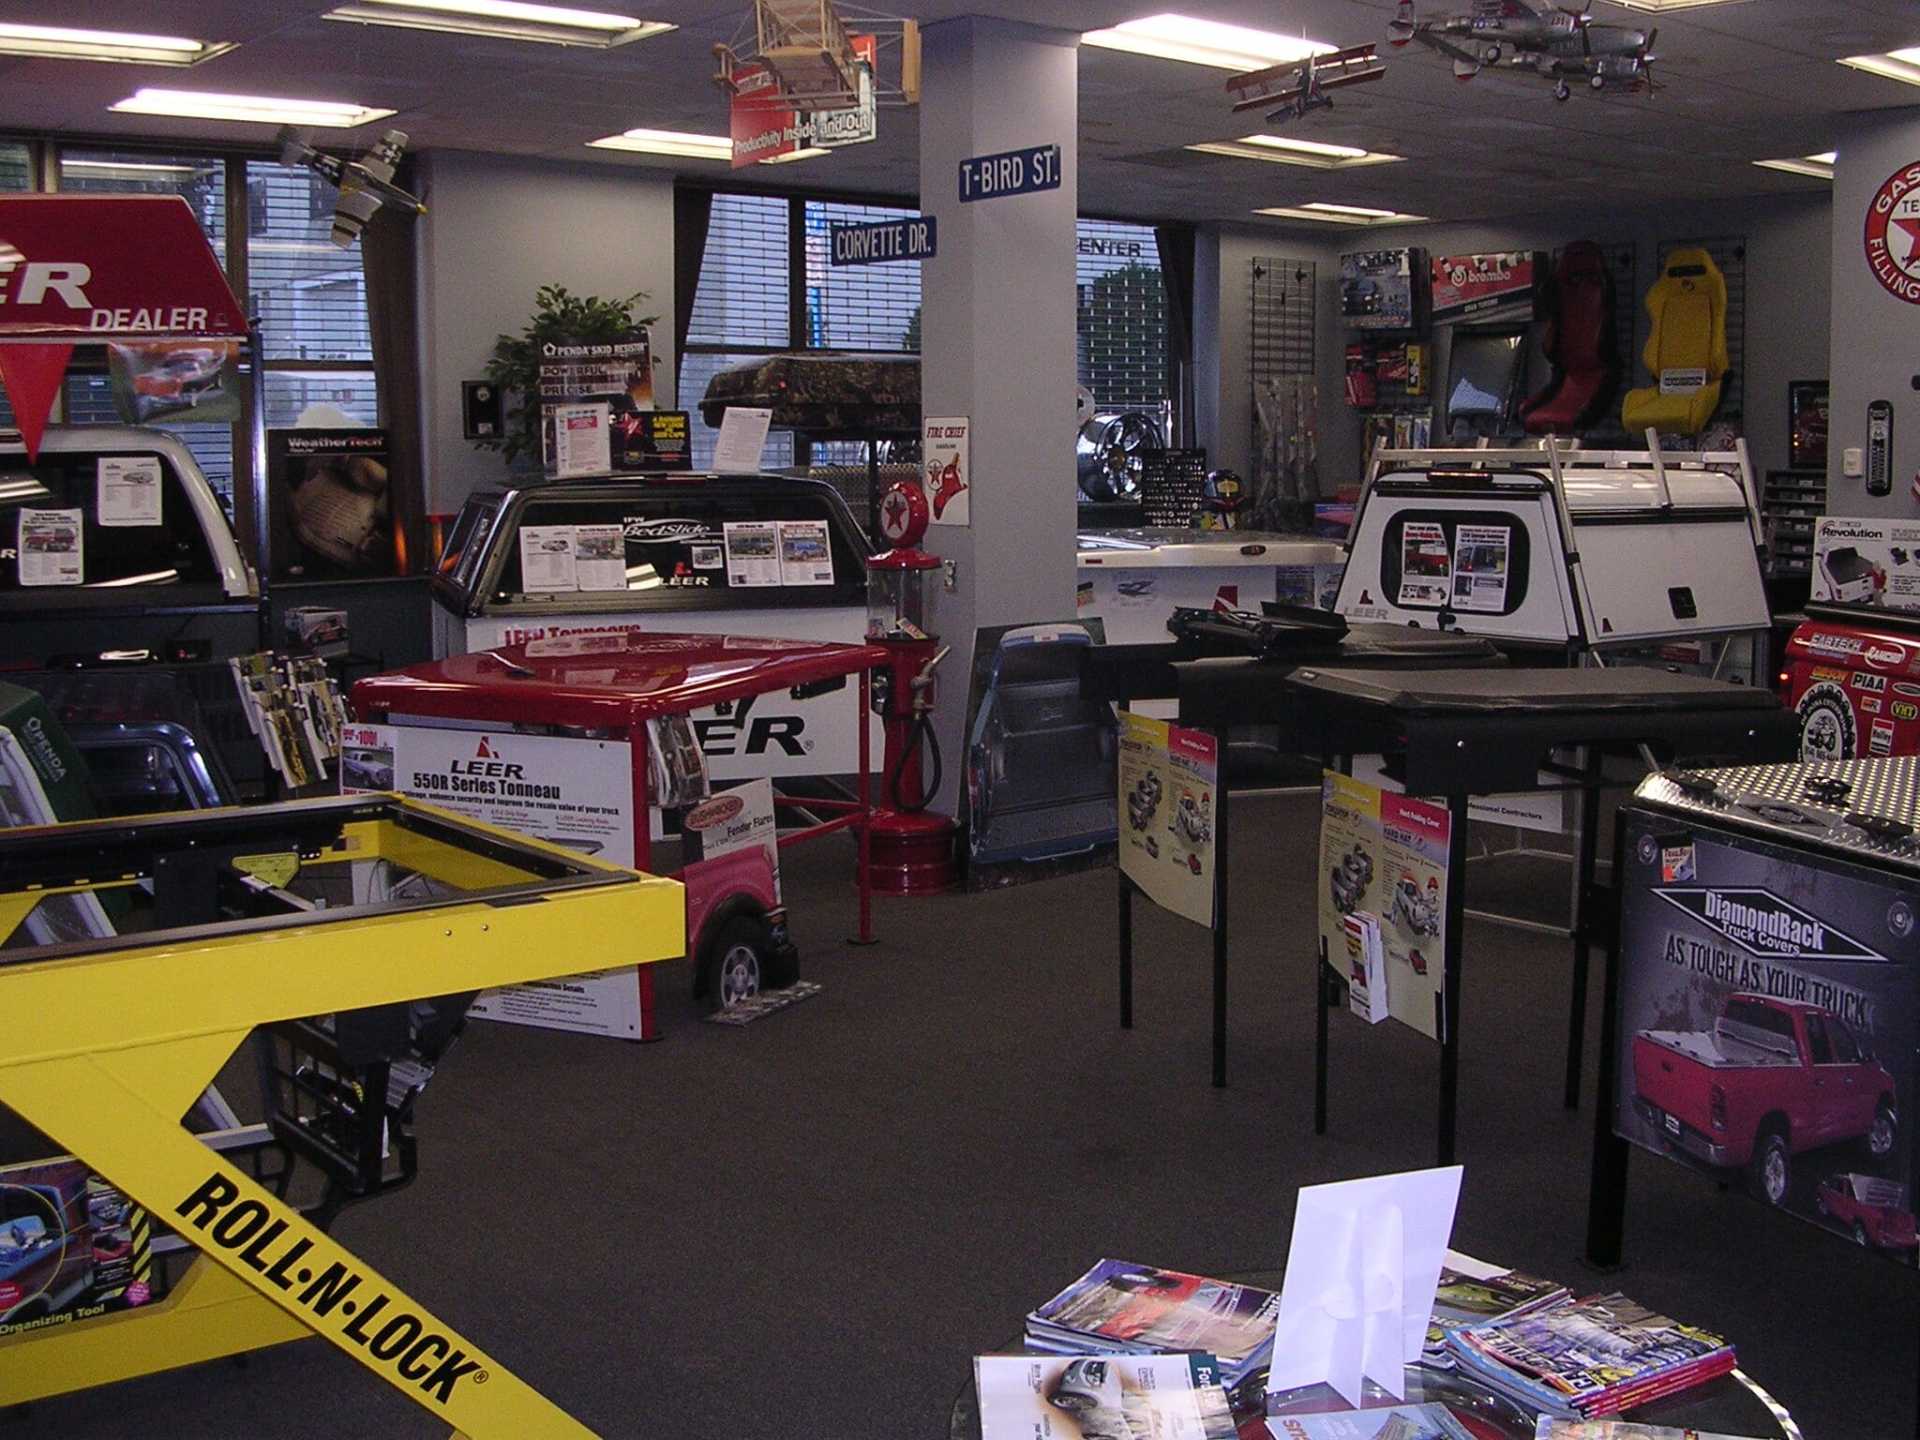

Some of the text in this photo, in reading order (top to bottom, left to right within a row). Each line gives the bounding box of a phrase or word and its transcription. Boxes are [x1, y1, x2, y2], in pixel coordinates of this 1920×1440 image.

[734, 111, 869, 154] Productivity Inside and Out
[962, 151, 1059, 195] T-BIRD ST.
[837, 222, 931, 260] CORVETTE DR.
[1077, 240, 1142, 257] ENTER
[1468, 268, 1511, 284] brembo
[90, 307, 209, 332] DEALER
[927, 426, 966, 438] FIRE CHIEF
[1822, 527, 1883, 539] Revolution
[1344, 607, 1389, 620] LEER
[1852, 674, 1885, 690] PIAA
[1894, 703, 1914, 718] VHT
[450, 760, 525, 780] LEER
[413, 772, 560, 800] 550R Series Tonneau
[1501, 807, 1543, 820] Contractors
[1705, 890, 1824, 950] DiamondBack
[1721, 921, 1801, 957] Truck Covers
[1665, 934, 1866, 1026] AS TOUGH AS YOUR TRUCK
[0, 1303, 105, 1335] Organizing Tool
